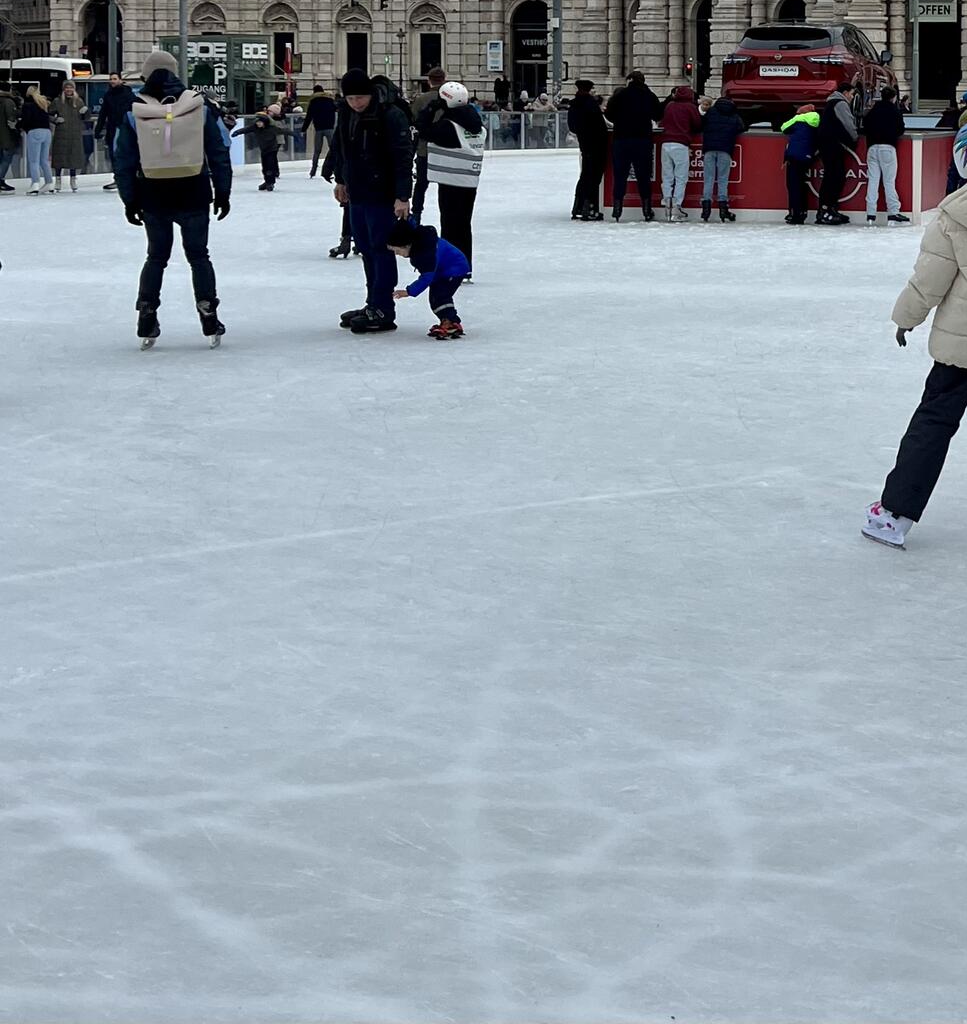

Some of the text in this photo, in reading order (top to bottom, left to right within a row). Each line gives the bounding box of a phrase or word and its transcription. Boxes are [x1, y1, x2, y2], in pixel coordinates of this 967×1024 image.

[919, 5, 950, 15] OFFEN
[522, 38, 548, 46] VESTIBÜ
[242, 43, 268, 59] BOE
